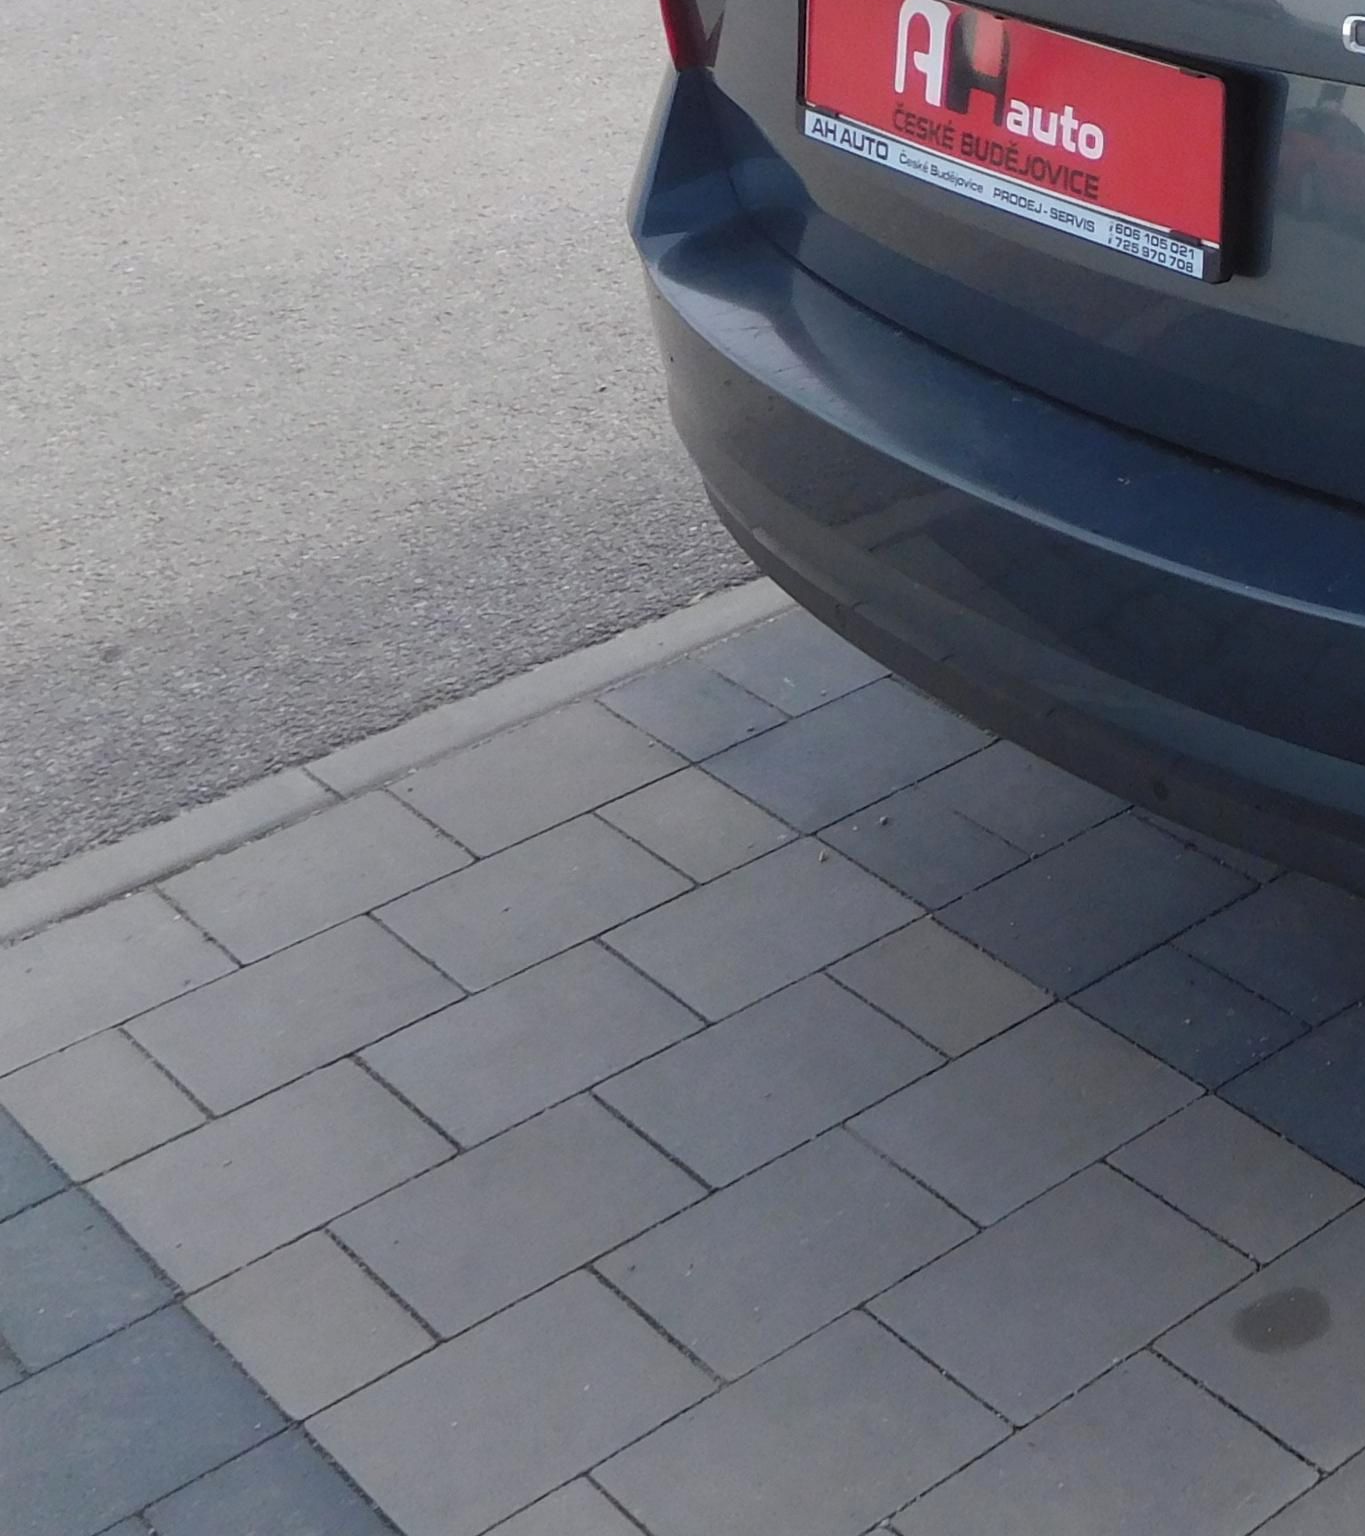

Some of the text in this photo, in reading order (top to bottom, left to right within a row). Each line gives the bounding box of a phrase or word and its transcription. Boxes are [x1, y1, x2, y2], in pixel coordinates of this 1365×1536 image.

[811, 117, 837, 142] AH
[840, 128, 889, 161] AUTO
[899, 149, 929, 174] České
[993, 187, 1043, 214] PRODEJ
[1049, 207, 1096, 233] SERVIS
[893, 103, 1100, 201] ČESKÉ BUDĚJOVICE
[1115, 237, 1194, 274] 725 970 708
[1144, 233, 1168, 250] 105
[1170, 242, 1195, 260] 021
